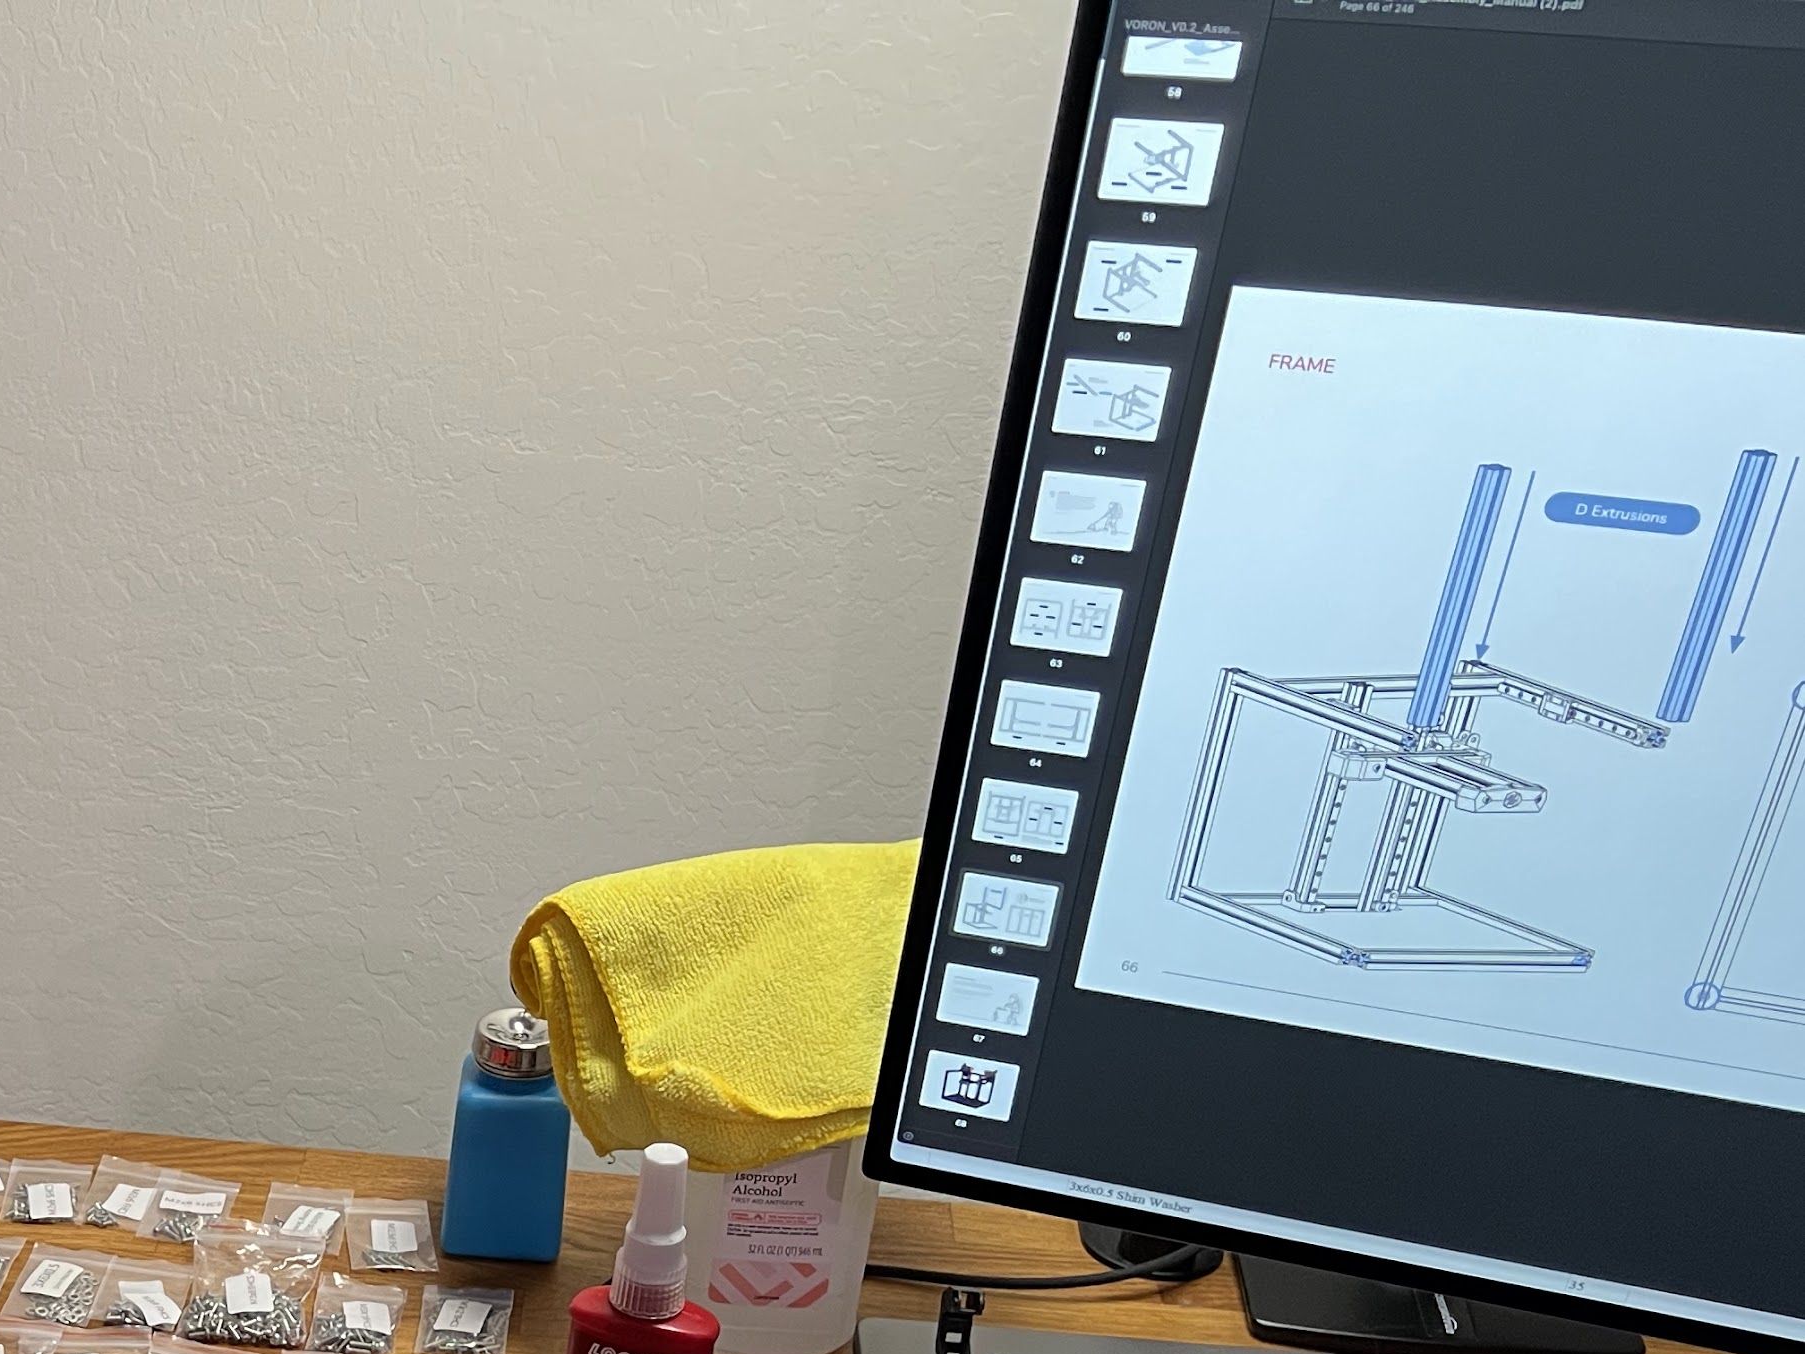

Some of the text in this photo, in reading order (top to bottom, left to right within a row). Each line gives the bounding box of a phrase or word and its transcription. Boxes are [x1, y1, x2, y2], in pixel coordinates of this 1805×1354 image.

[1340, 1, 1363, 12] Page
[1366, 2, 1380, 12] 66
[1382, 3, 1393, 12] of
[1116, 331, 1132, 342] 60
[1268, 353, 1337, 374] FRAME
[1093, 446, 1107, 456] 61
[1575, 503, 1668, 524] D Extrusions
[1071, 554, 1085, 565] 62
[1049, 658, 1063, 669] 63
[1029, 758, 1042, 768] 64
[1009, 853, 1023, 864] 65
[1121, 959, 1139, 973] 66
[735, 1171, 797, 1186] Isopropyl
[732, 1185, 783, 1197] Alcohol
[1069, 1181, 1193, 1214] 3x6x0.5 Shim Washer
[1568, 1281, 1585, 1291] 35
